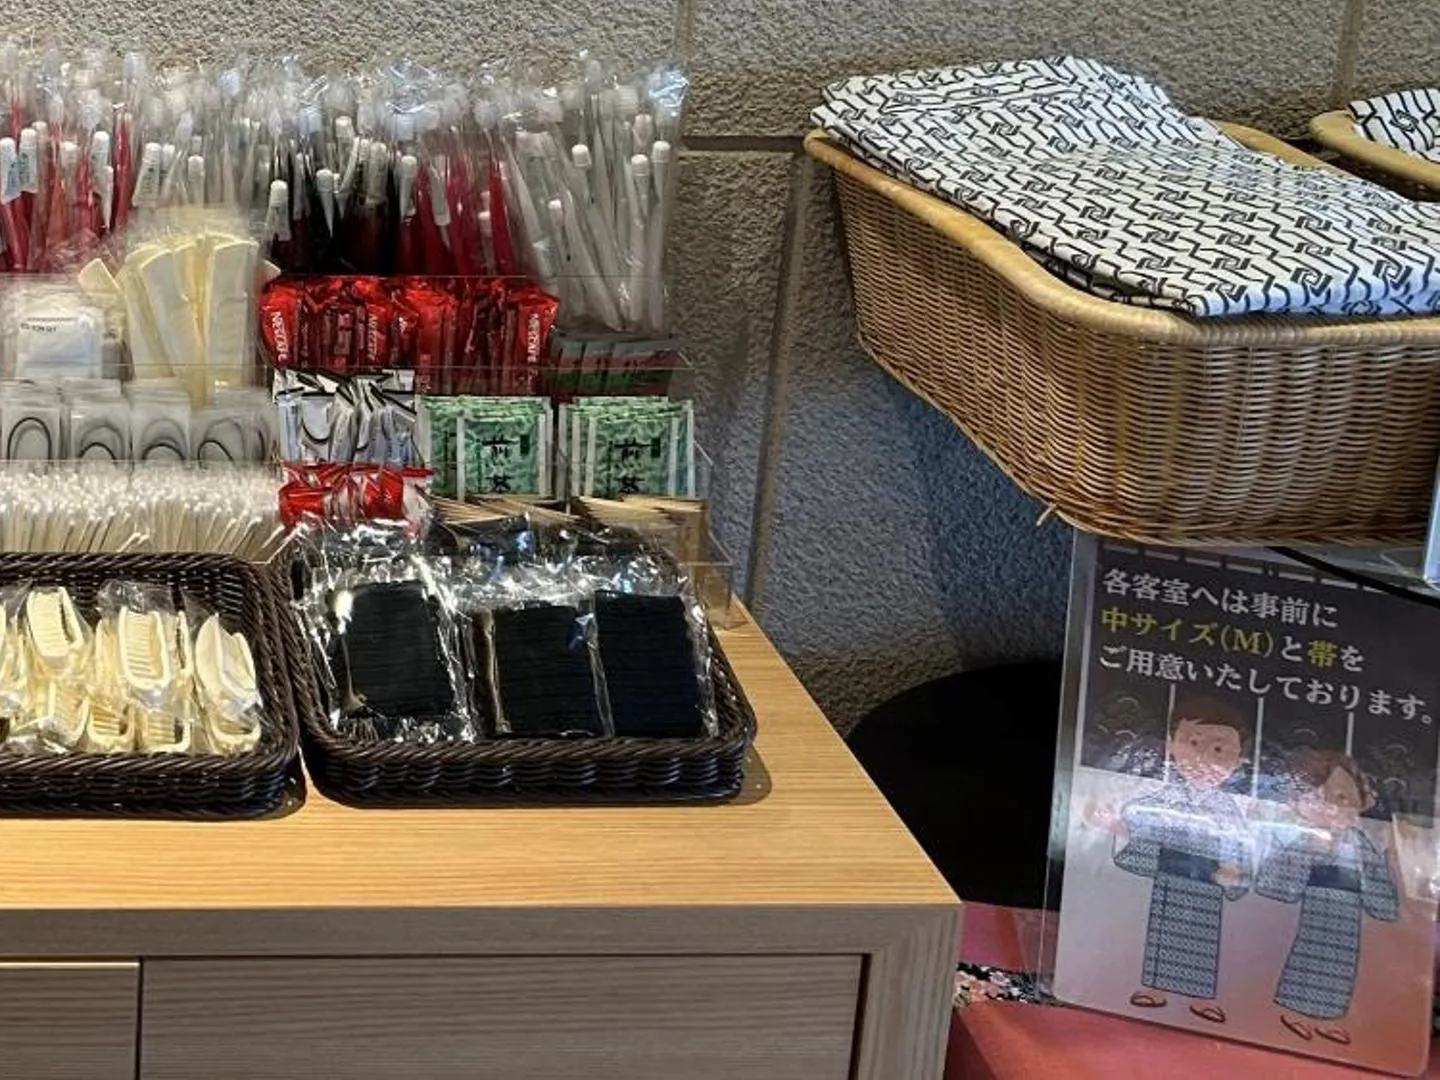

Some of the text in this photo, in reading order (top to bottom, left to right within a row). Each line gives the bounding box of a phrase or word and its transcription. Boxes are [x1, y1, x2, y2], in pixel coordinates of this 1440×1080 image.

[1102, 568, 1339, 628] 各客室へは事前に
[1101, 607, 1365, 672] 中サイズ(M)と帯を
[1098, 644, 1433, 725] ご用意いたしております。
